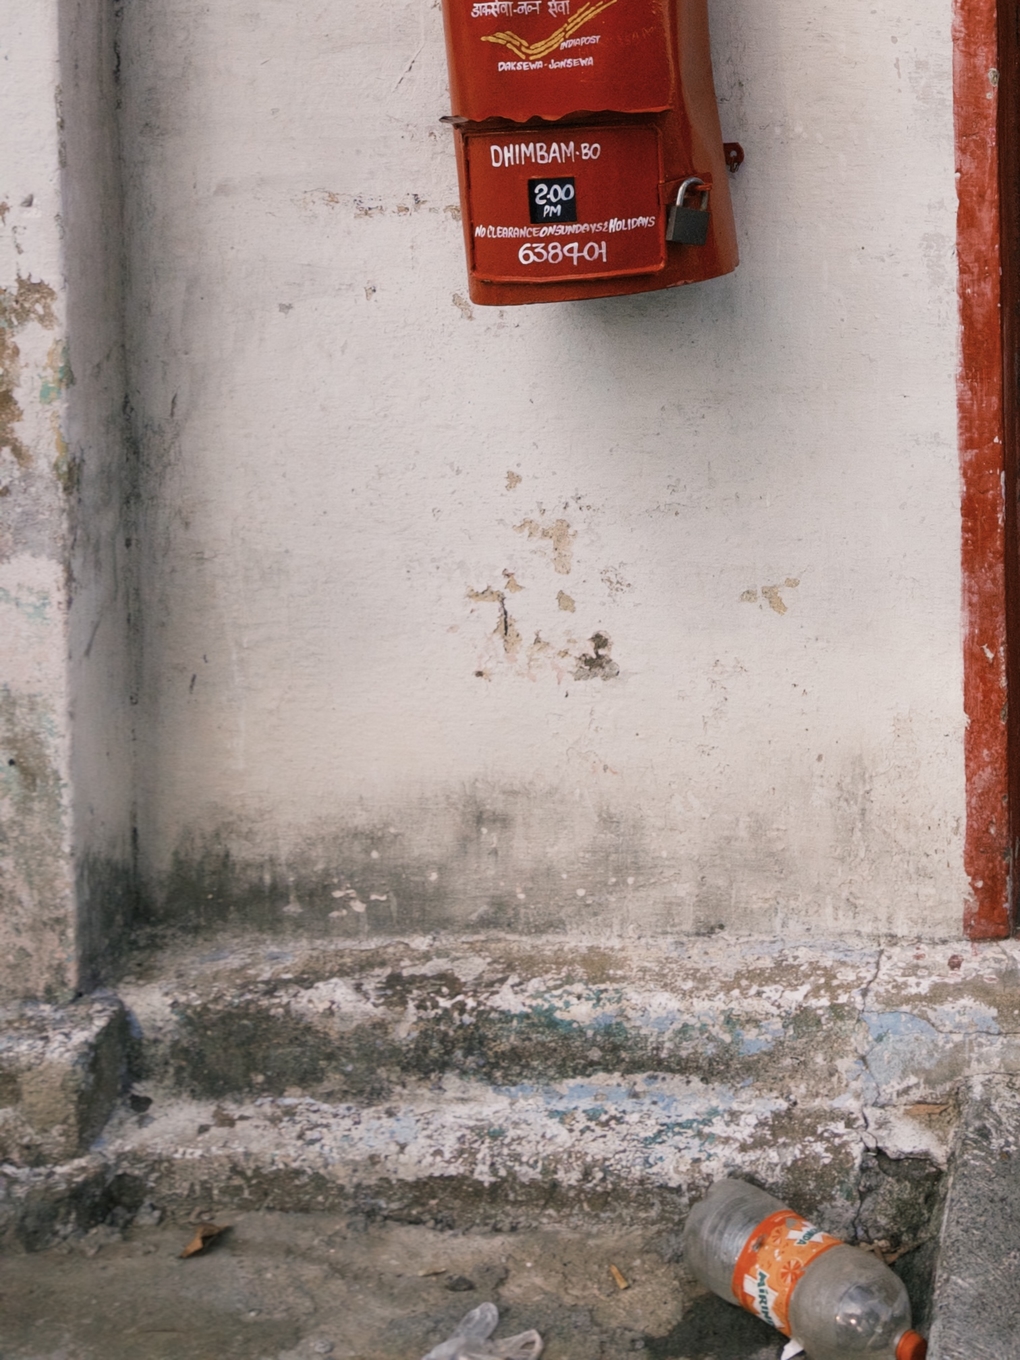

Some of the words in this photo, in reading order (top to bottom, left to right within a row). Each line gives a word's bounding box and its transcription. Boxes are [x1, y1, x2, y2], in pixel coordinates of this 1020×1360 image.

[543, 204, 562, 218] PM
[475, 225, 487, 238] NO
[487, 226, 540, 239] CLEARANCE
[609, 216, 656, 233] HOLIDAYS
[518, 241, 607, 266] 638401
